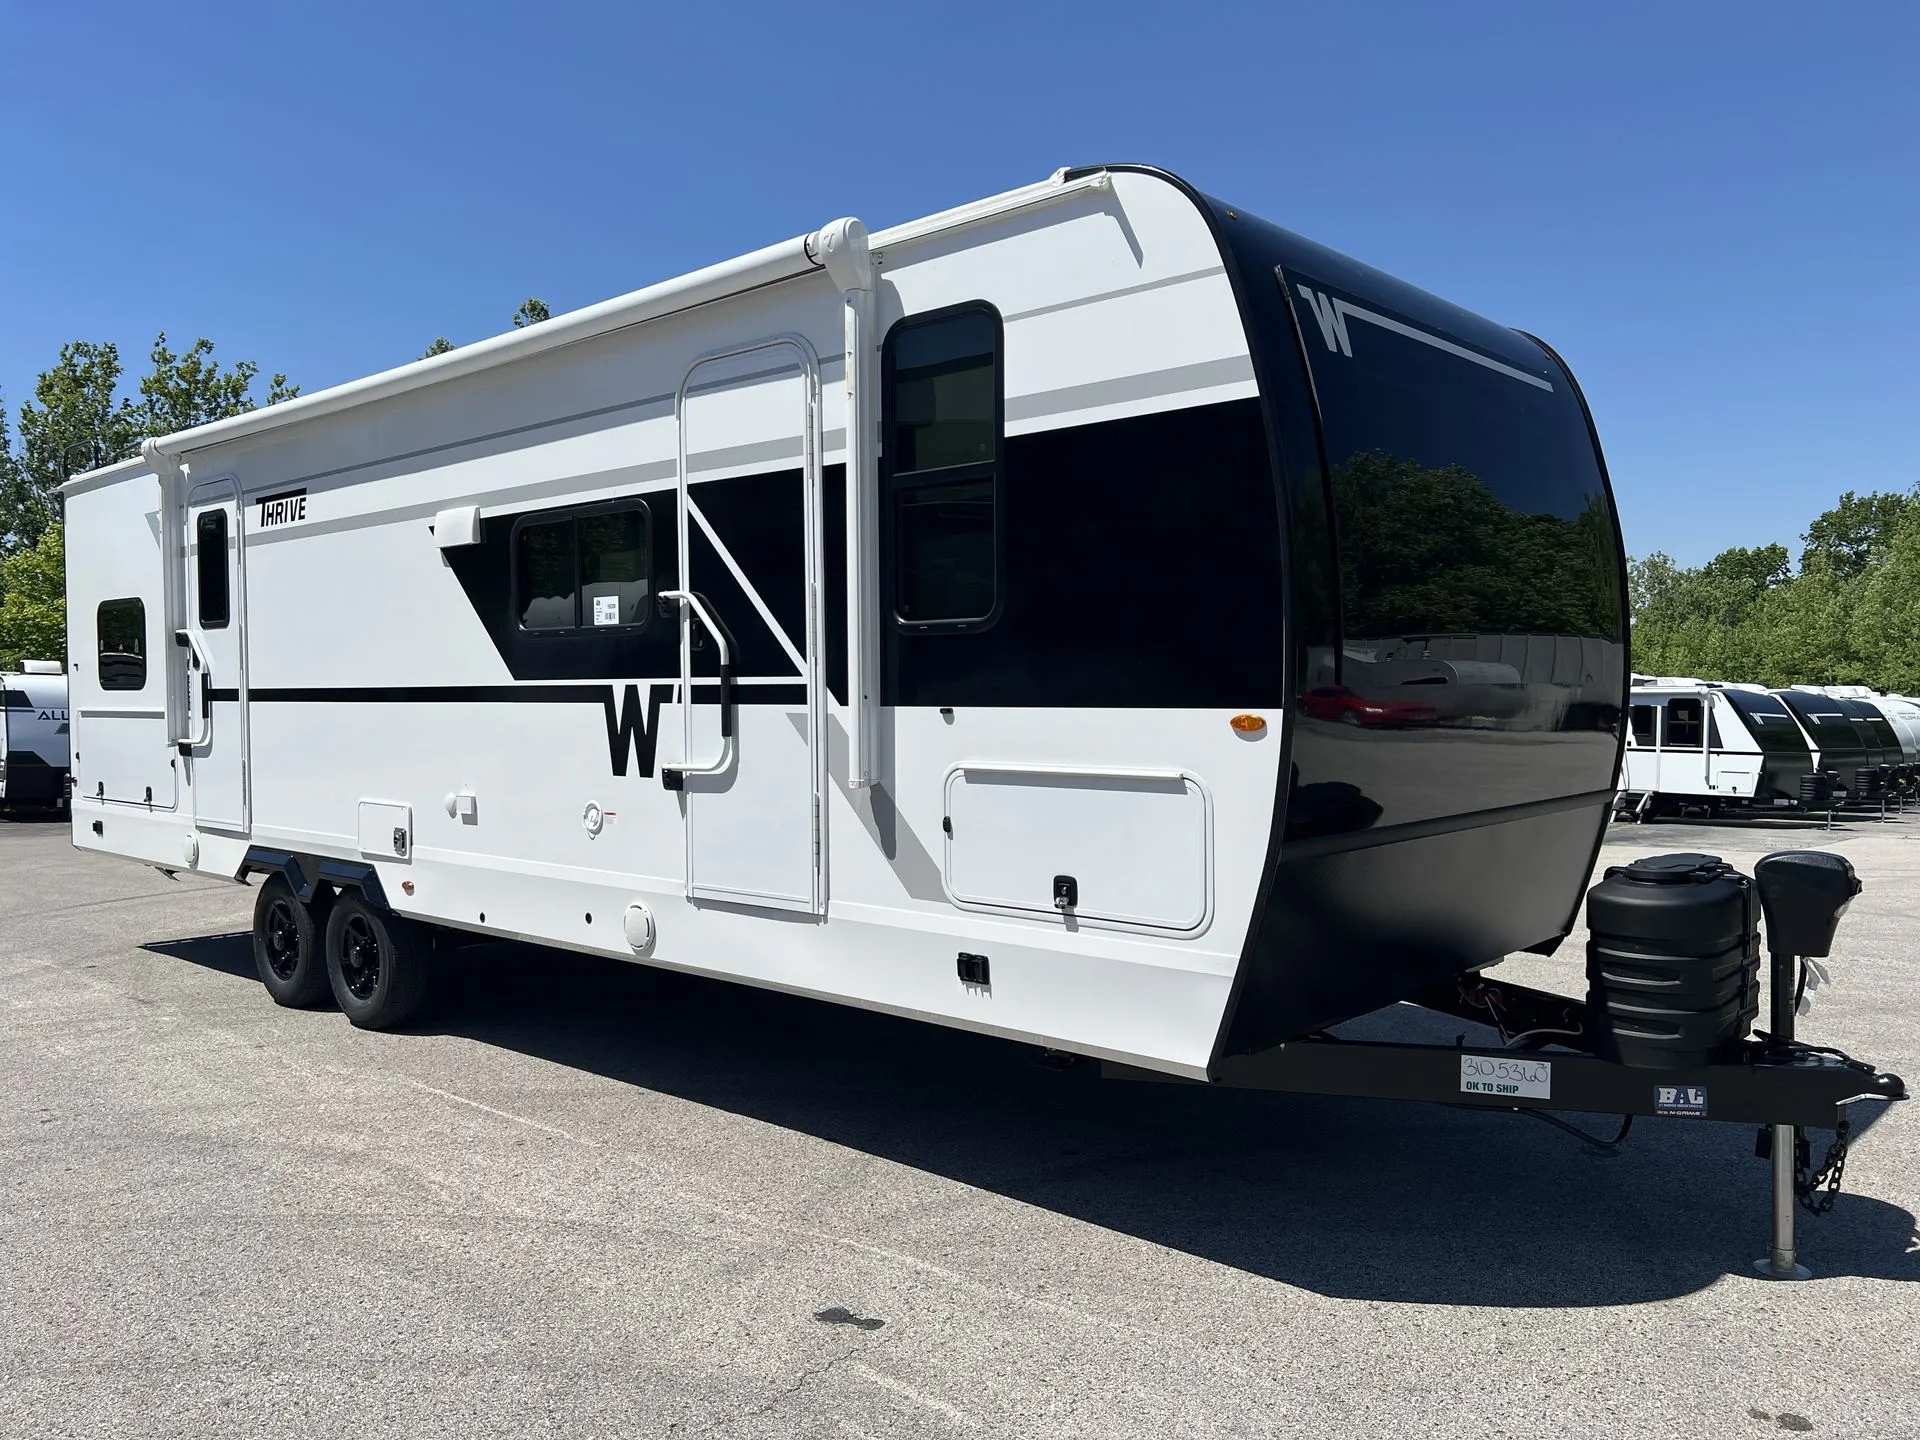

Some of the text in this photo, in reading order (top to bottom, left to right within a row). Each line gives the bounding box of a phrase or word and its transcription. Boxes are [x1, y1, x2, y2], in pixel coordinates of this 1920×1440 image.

[256, 487, 307, 528] THRIVE
[603, 684, 674, 778] W
[1466, 1081, 1519, 1094] OK TO SHIP
